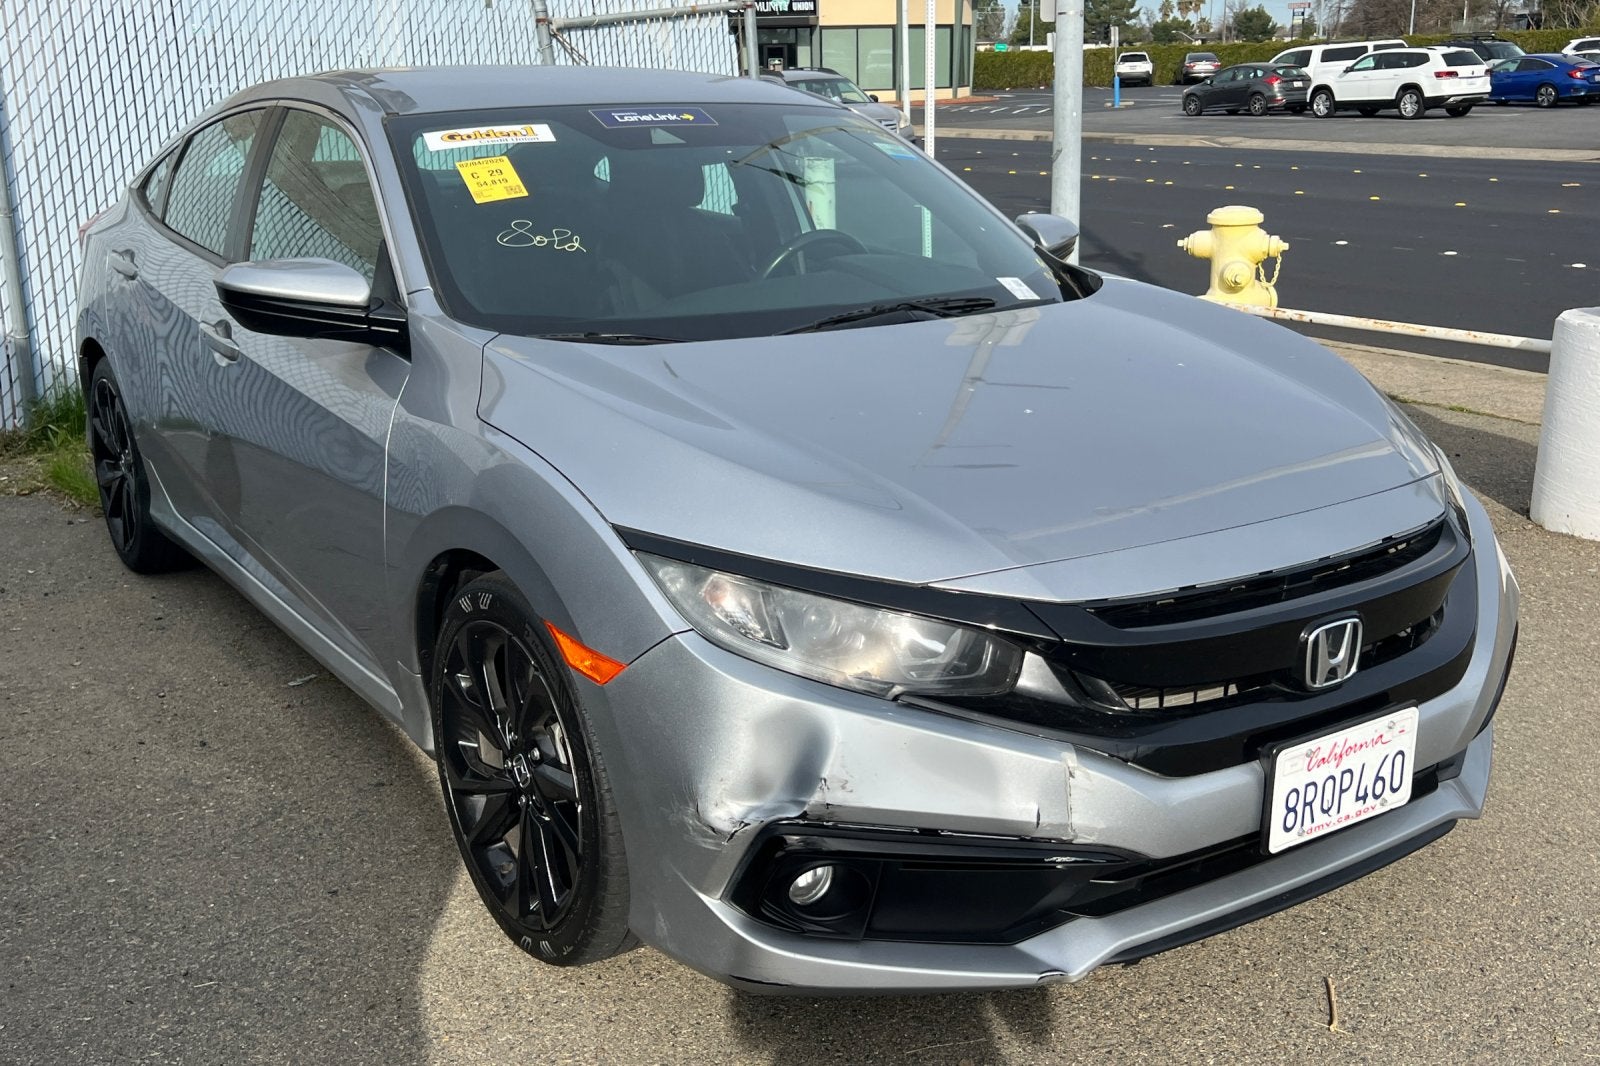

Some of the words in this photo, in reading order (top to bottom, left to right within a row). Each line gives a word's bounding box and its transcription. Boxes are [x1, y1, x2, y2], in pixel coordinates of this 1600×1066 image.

[792, 2, 814, 11] UNION
[614, 113, 681, 122] LaneLink
[471, 171, 480, 179] C
[488, 168, 504, 177] 29
[1306, 733, 1392, 772] California
[1282, 750, 1405, 833] 8RQP460
[1306, 804, 1377, 835] dmv.ca.gov
